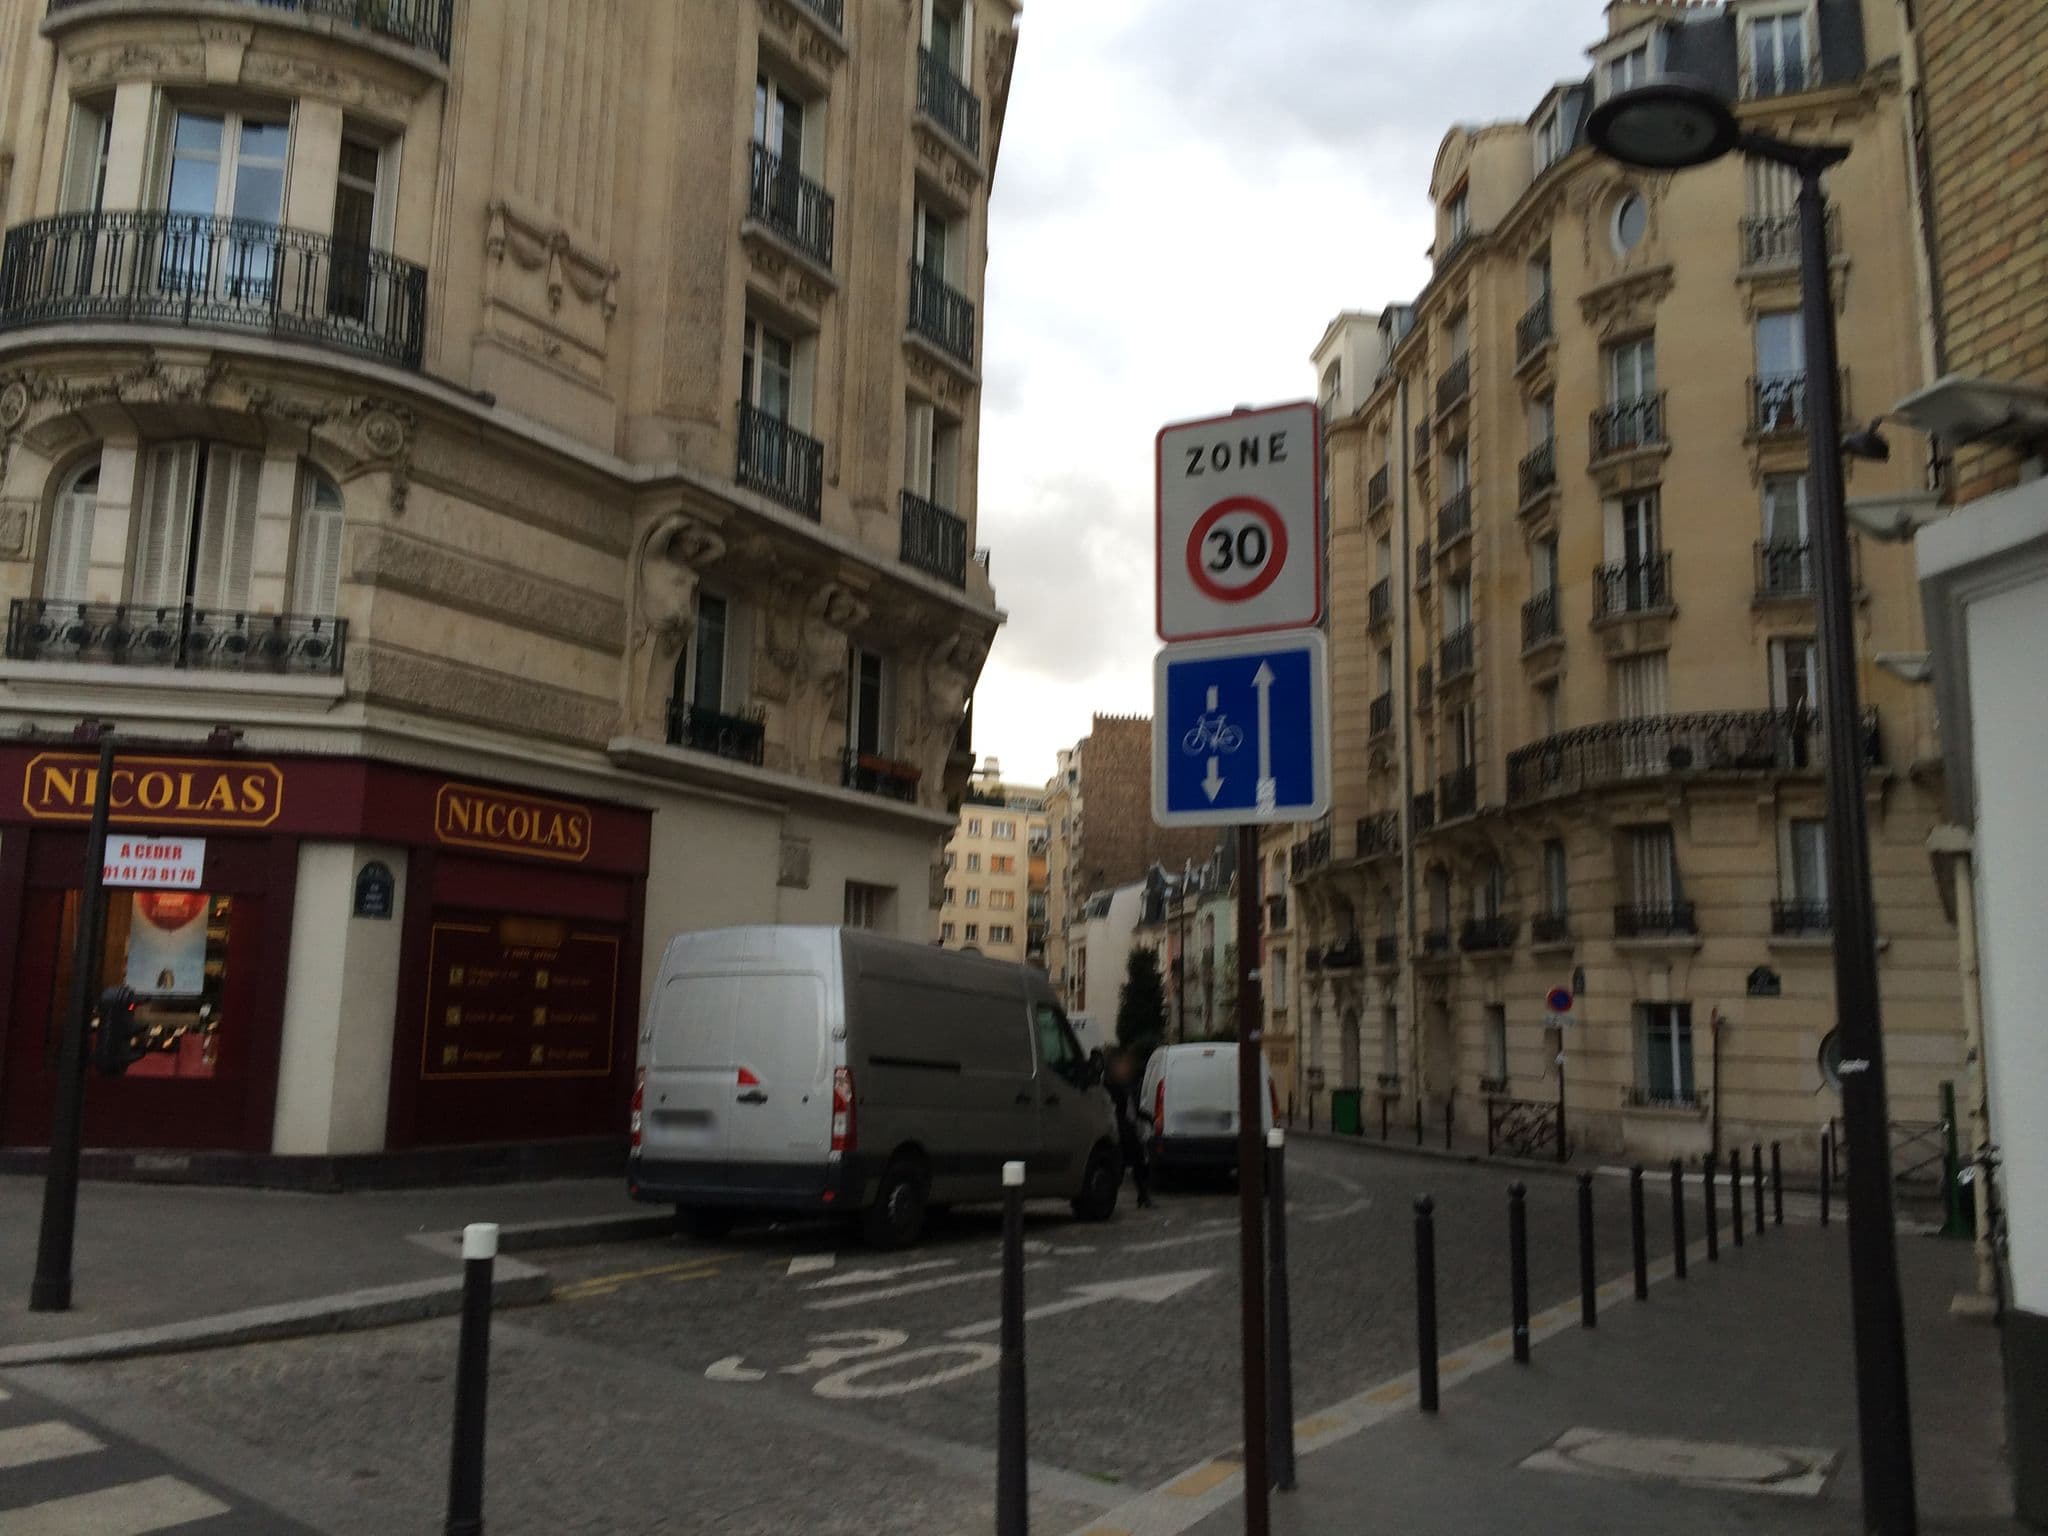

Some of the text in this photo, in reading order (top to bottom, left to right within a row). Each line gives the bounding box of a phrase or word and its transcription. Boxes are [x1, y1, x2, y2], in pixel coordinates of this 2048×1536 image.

[1185, 430, 1288, 479] ZONE
[1207, 523, 1267, 573] 30
[40, 766, 266, 813] NICOLAS
[447, 796, 582, 849] NICOLAS
